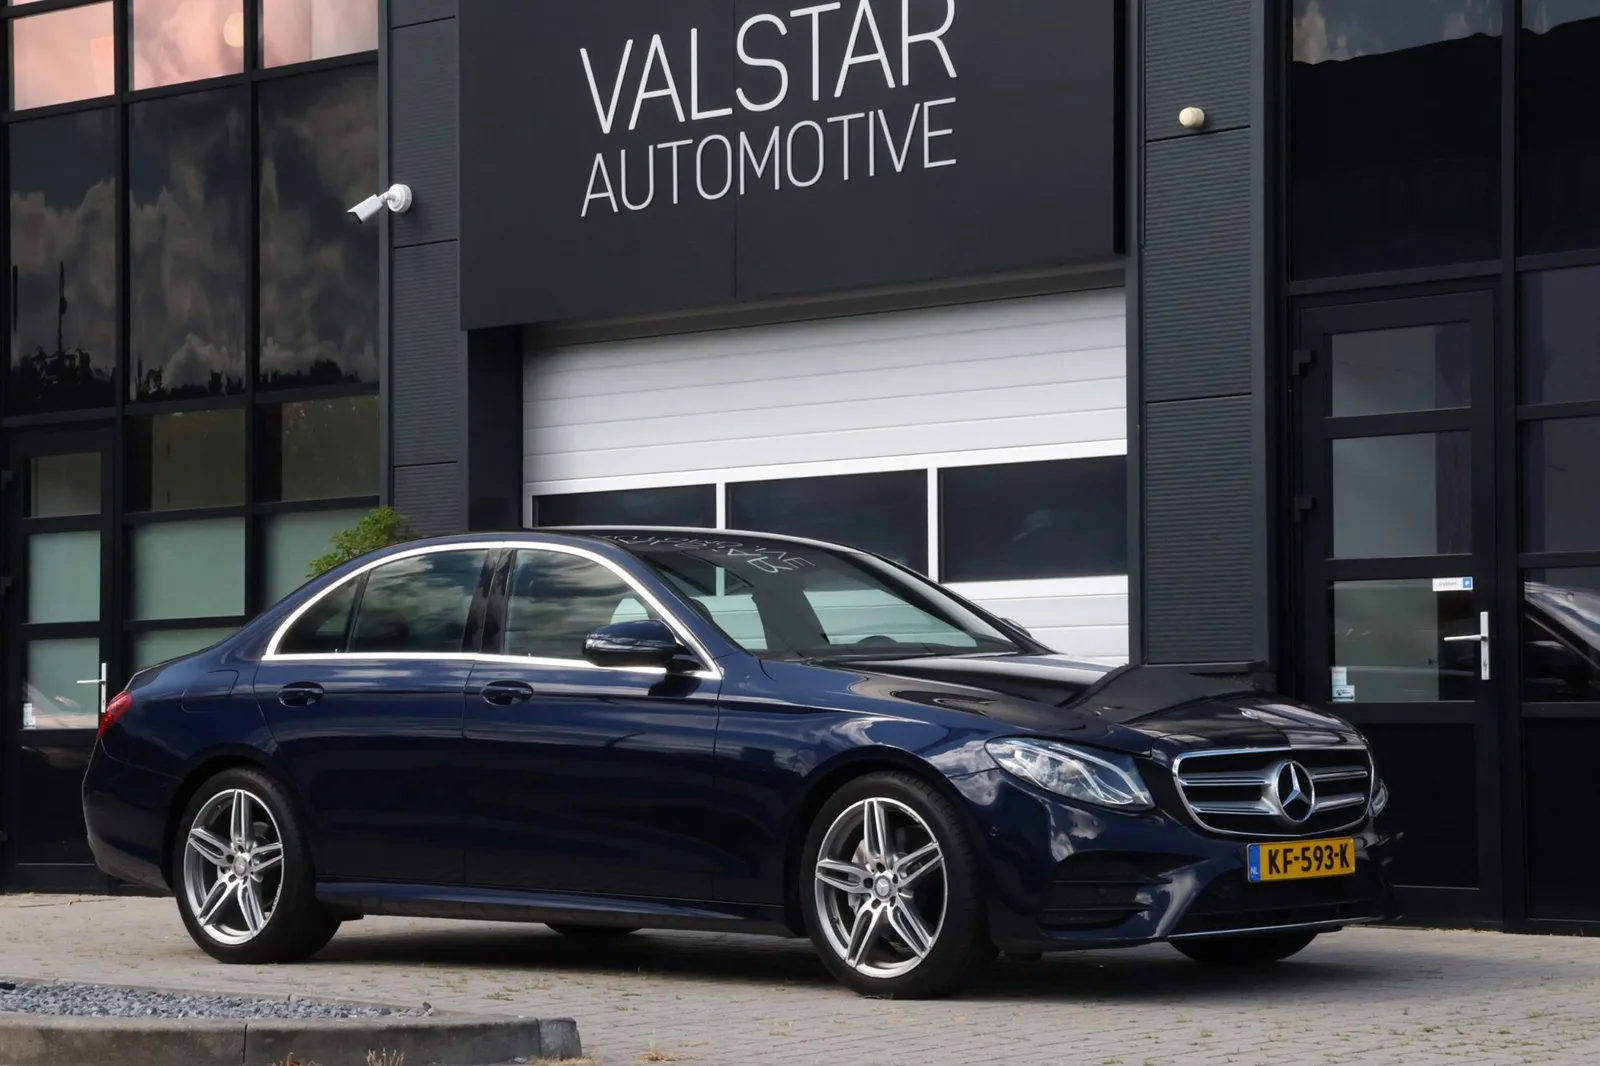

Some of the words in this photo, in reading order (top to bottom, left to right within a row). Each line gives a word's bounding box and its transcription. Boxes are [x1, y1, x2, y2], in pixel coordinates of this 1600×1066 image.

[580, 0, 957, 134] VALSTAR
[580, 97, 957, 217] AUTOMOTIVE
[1250, 866, 1259, 875] NL
[1268, 843, 1350, 875] KF-593-K
